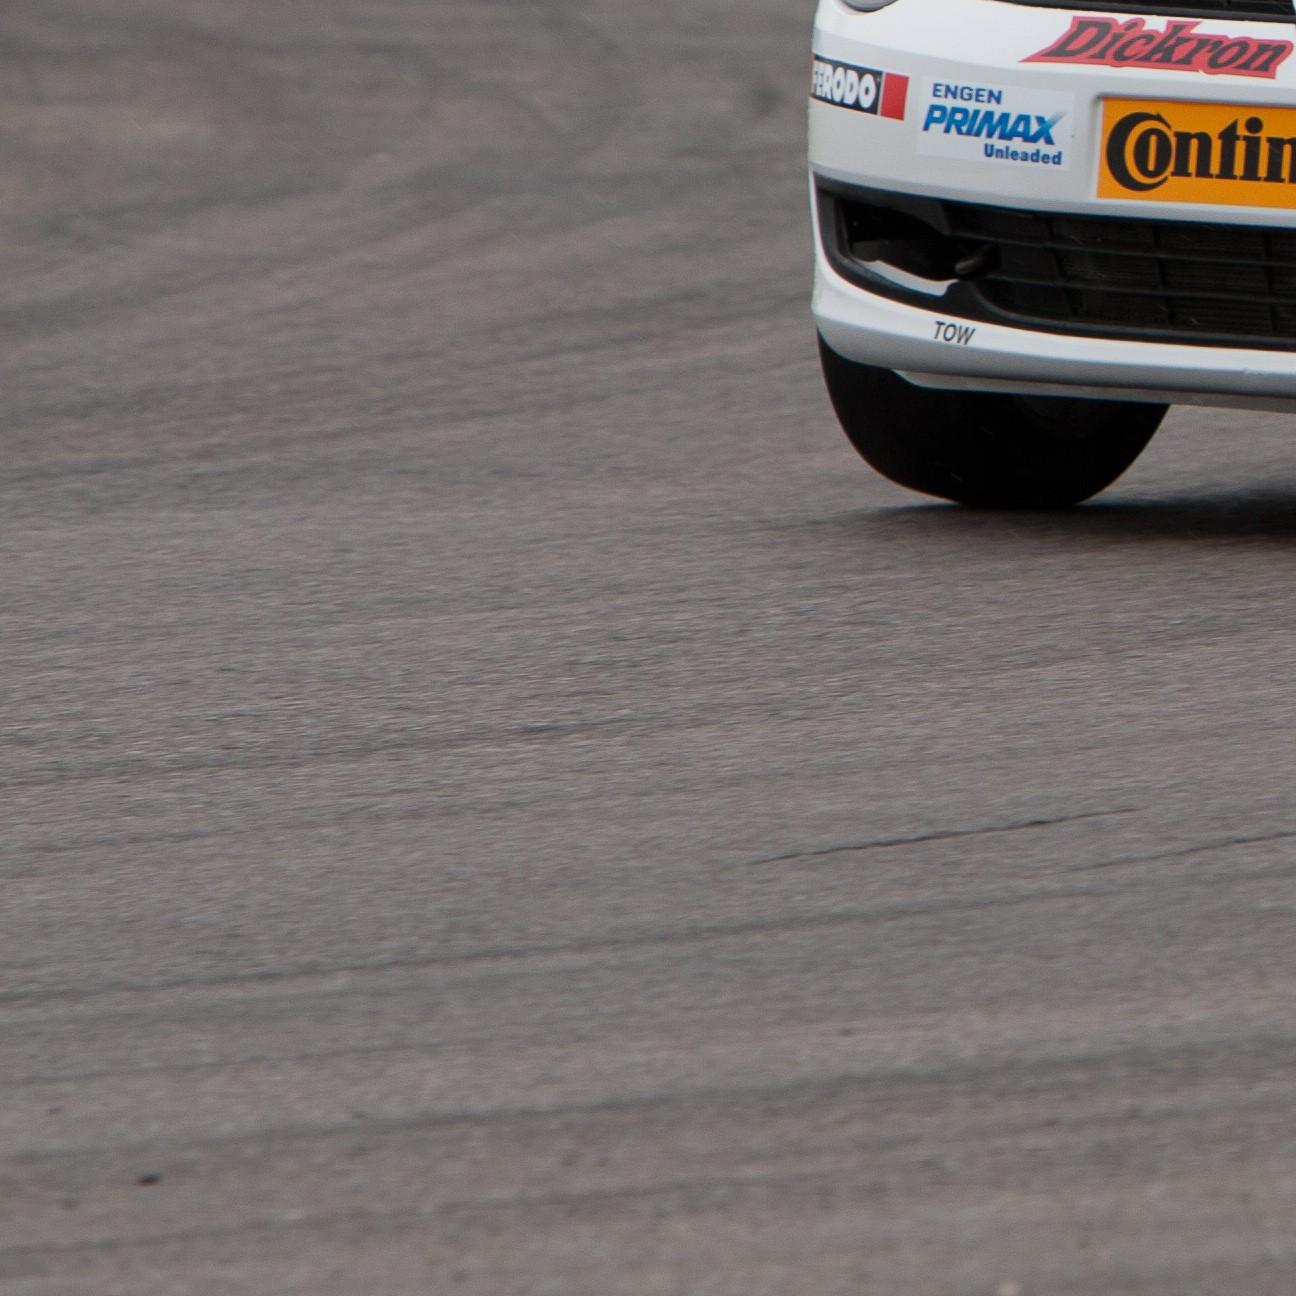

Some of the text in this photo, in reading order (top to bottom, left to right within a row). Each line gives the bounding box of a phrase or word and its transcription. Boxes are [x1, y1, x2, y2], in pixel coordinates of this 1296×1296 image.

[1045, 16, 1292, 76] Dickron
[931, 82, 1004, 106] ENGEN
[921, 104, 1065, 146] PRIMAX
[983, 142, 1064, 166] Unleaded
[932, 320, 977, 347] TOW
